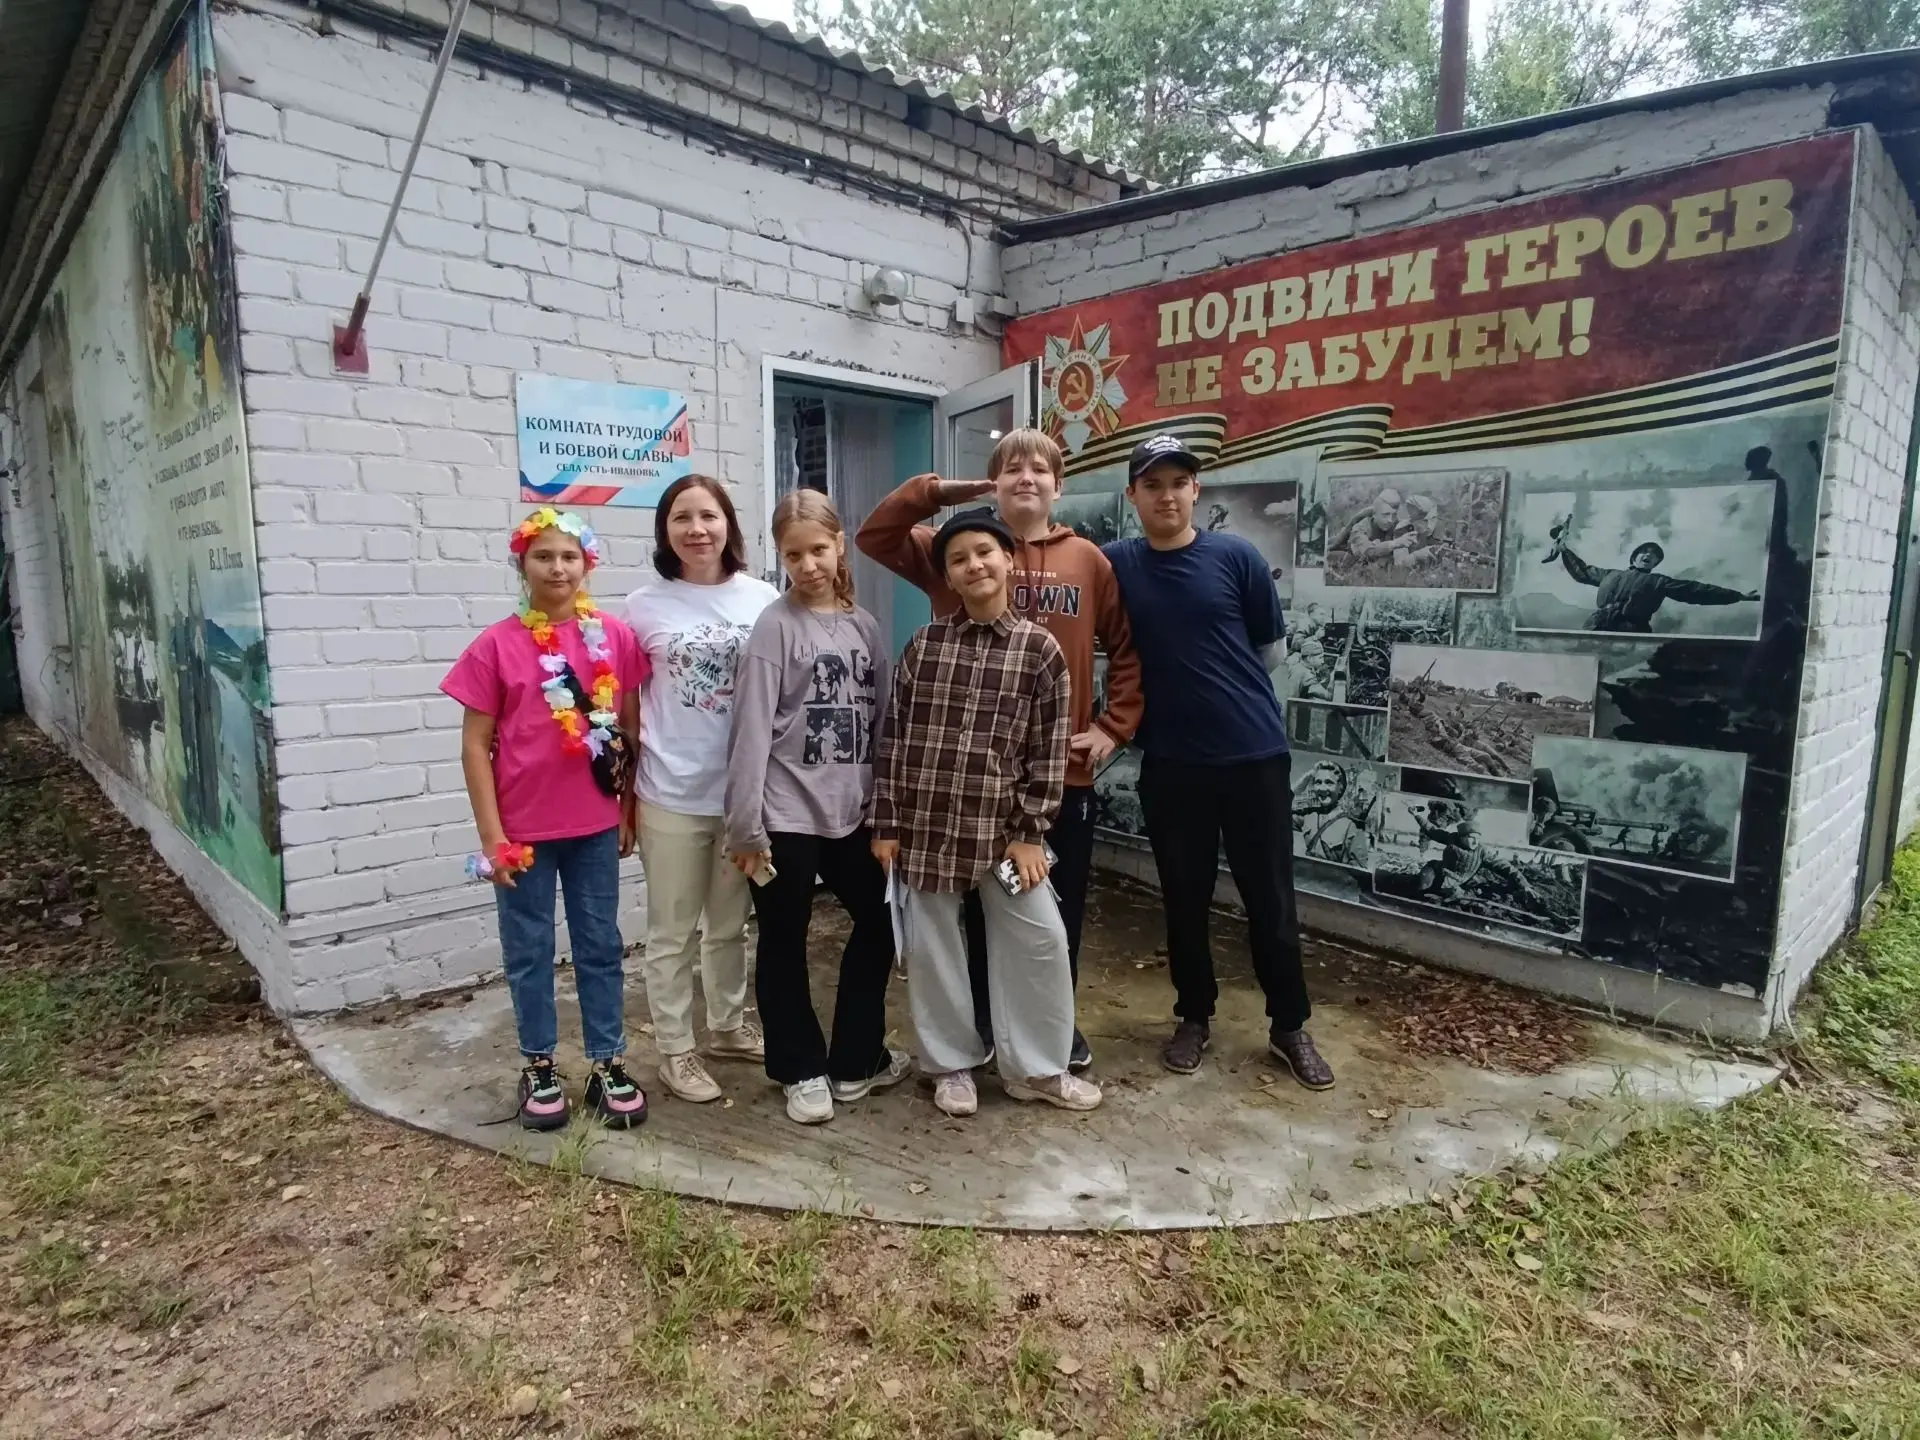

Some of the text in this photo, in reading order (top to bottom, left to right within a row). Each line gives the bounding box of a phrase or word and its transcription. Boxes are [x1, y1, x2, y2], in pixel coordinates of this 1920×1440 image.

[1157, 179, 1794, 348] ПОДВИГИ ГЕРОЕВ
[1154, 297, 1595, 408] НЕ ЗАБУДЕМ!
[526, 416, 683, 443] КОМНАТА ТРУДОВОЙ
[539, 441, 674, 464] И БОЕВОЙ СЛАВЫ
[556, 462, 660, 478] СЕЛА УСТЬ-ИВАНОВКА
